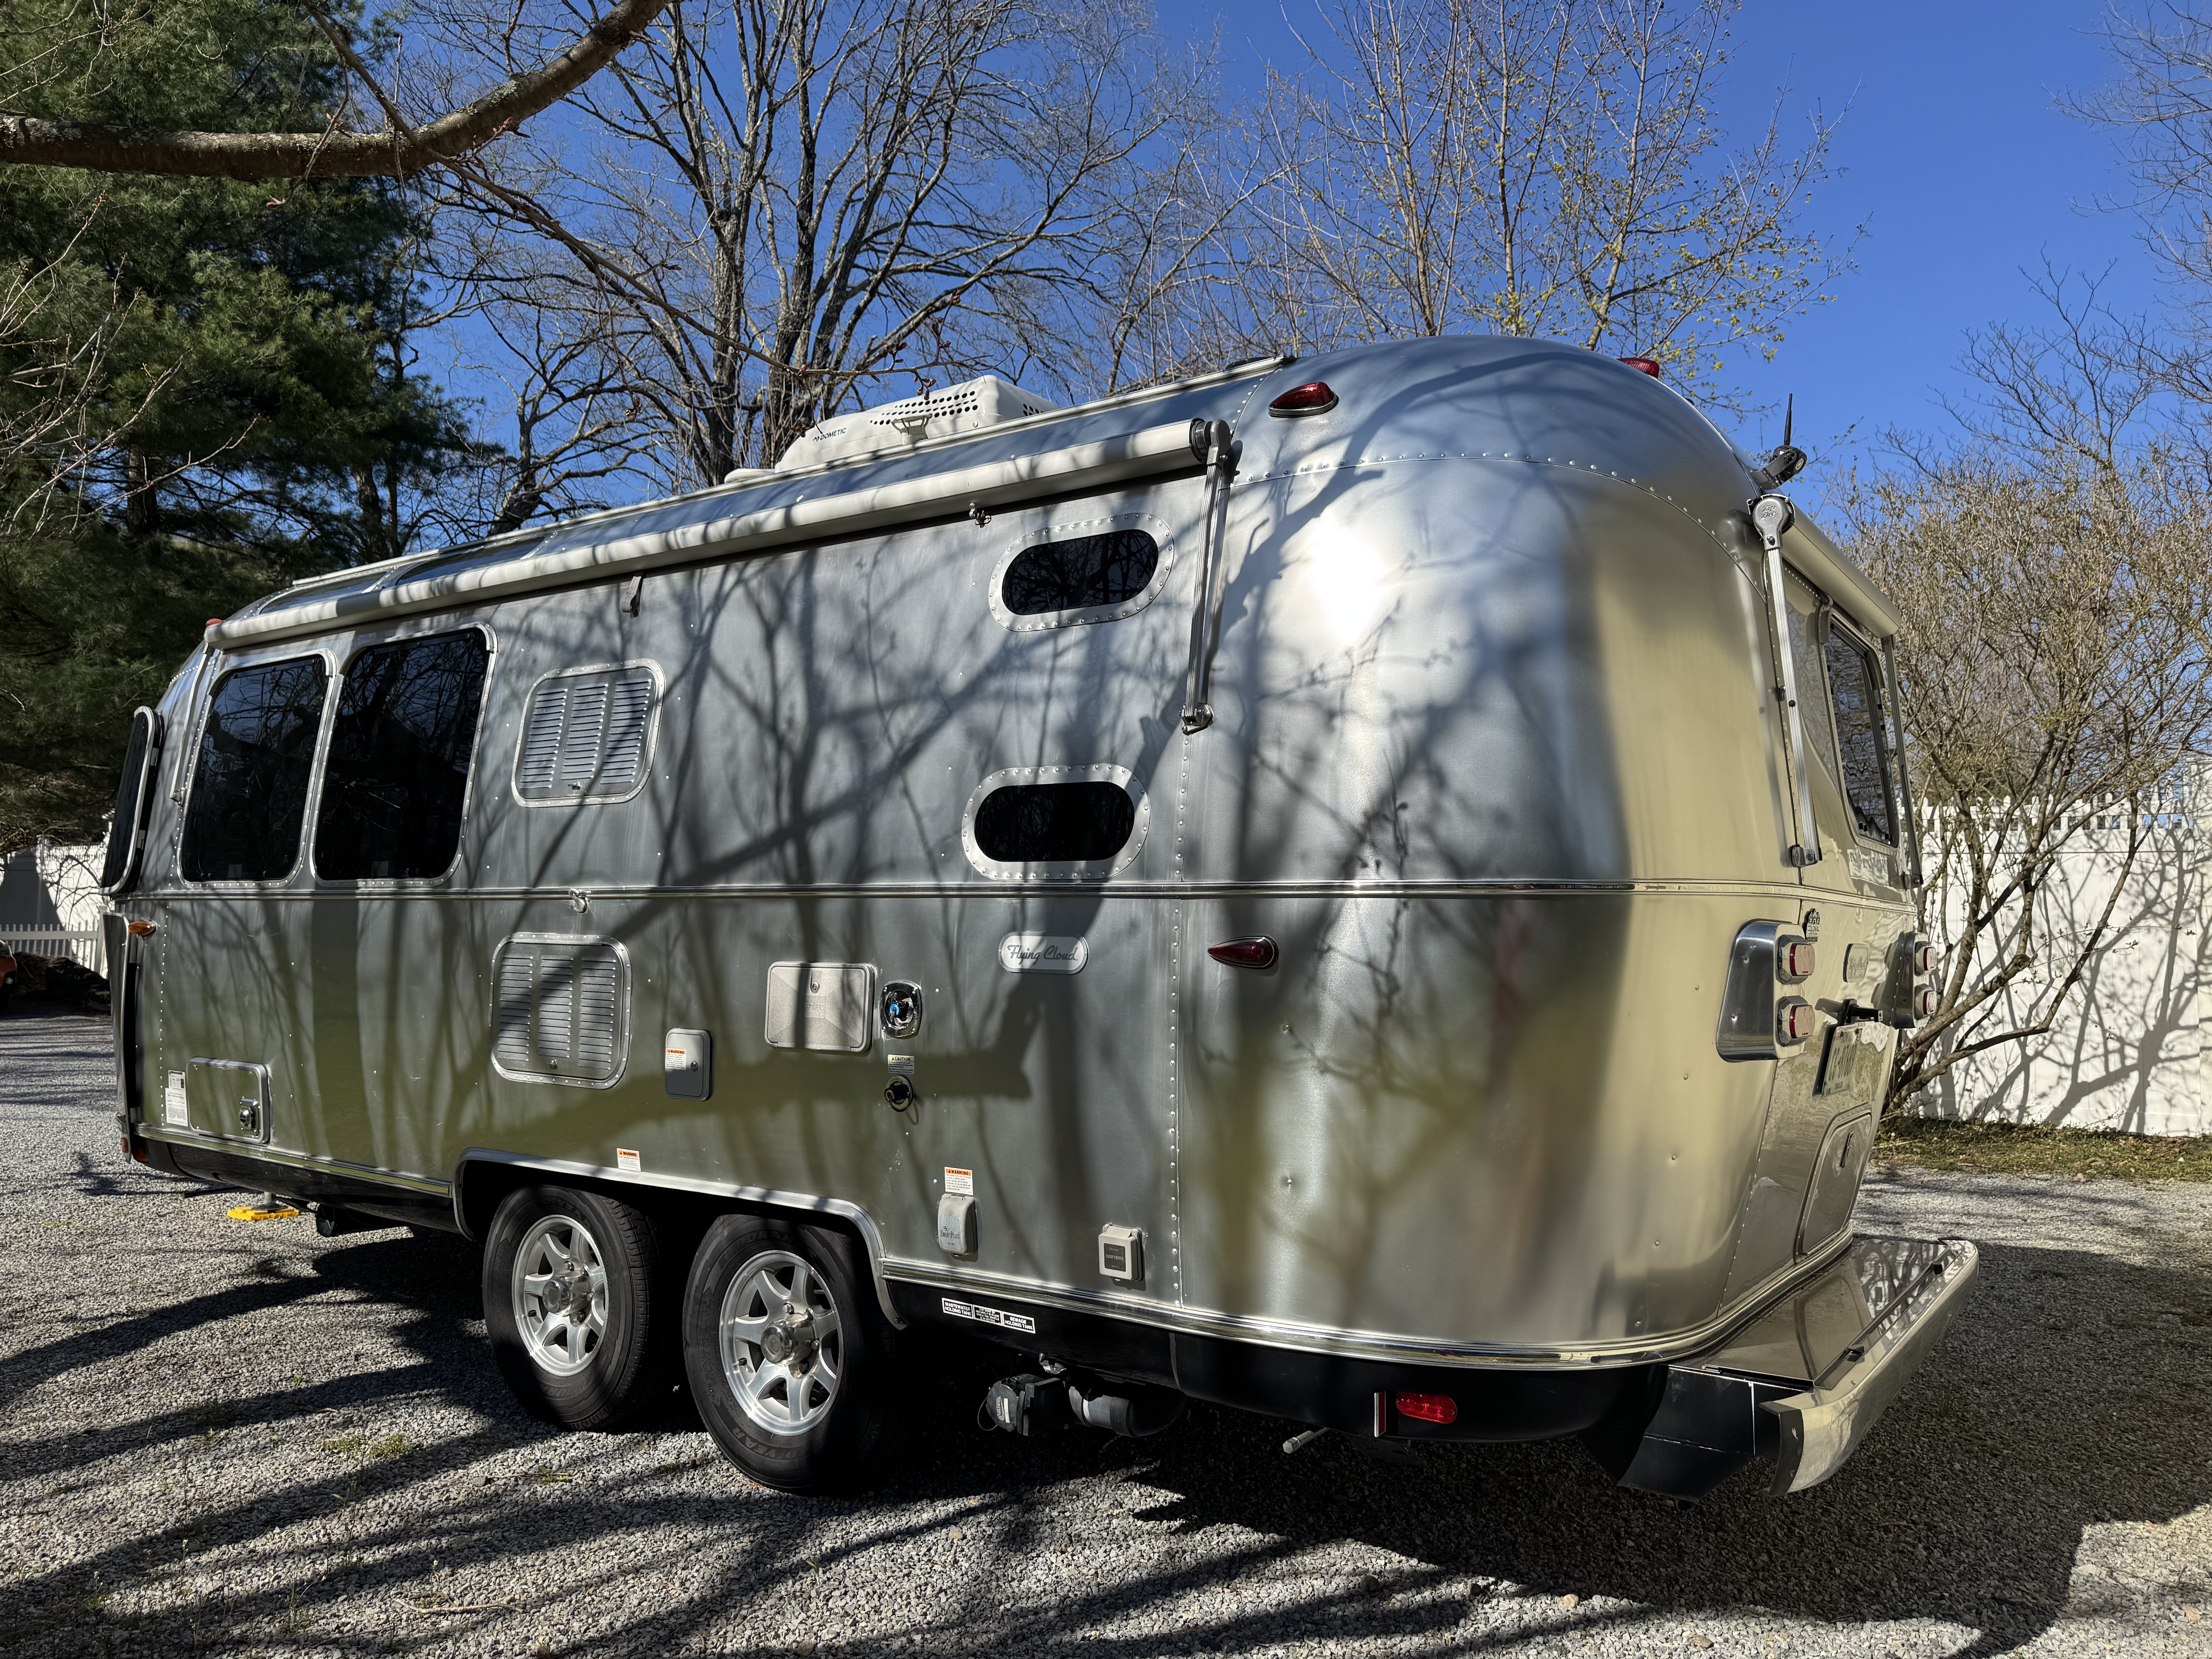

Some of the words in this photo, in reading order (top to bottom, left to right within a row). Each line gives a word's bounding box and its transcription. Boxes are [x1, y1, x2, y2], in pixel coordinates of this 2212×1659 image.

[820, 428, 847, 440] DOMETIC
[1007, 945, 1042, 965] Flying
[1043, 945, 1079, 961] Cloud
[945, 1302, 970, 1311] WASTEWATER
[1005, 1320, 1022, 1328] HOLDING
